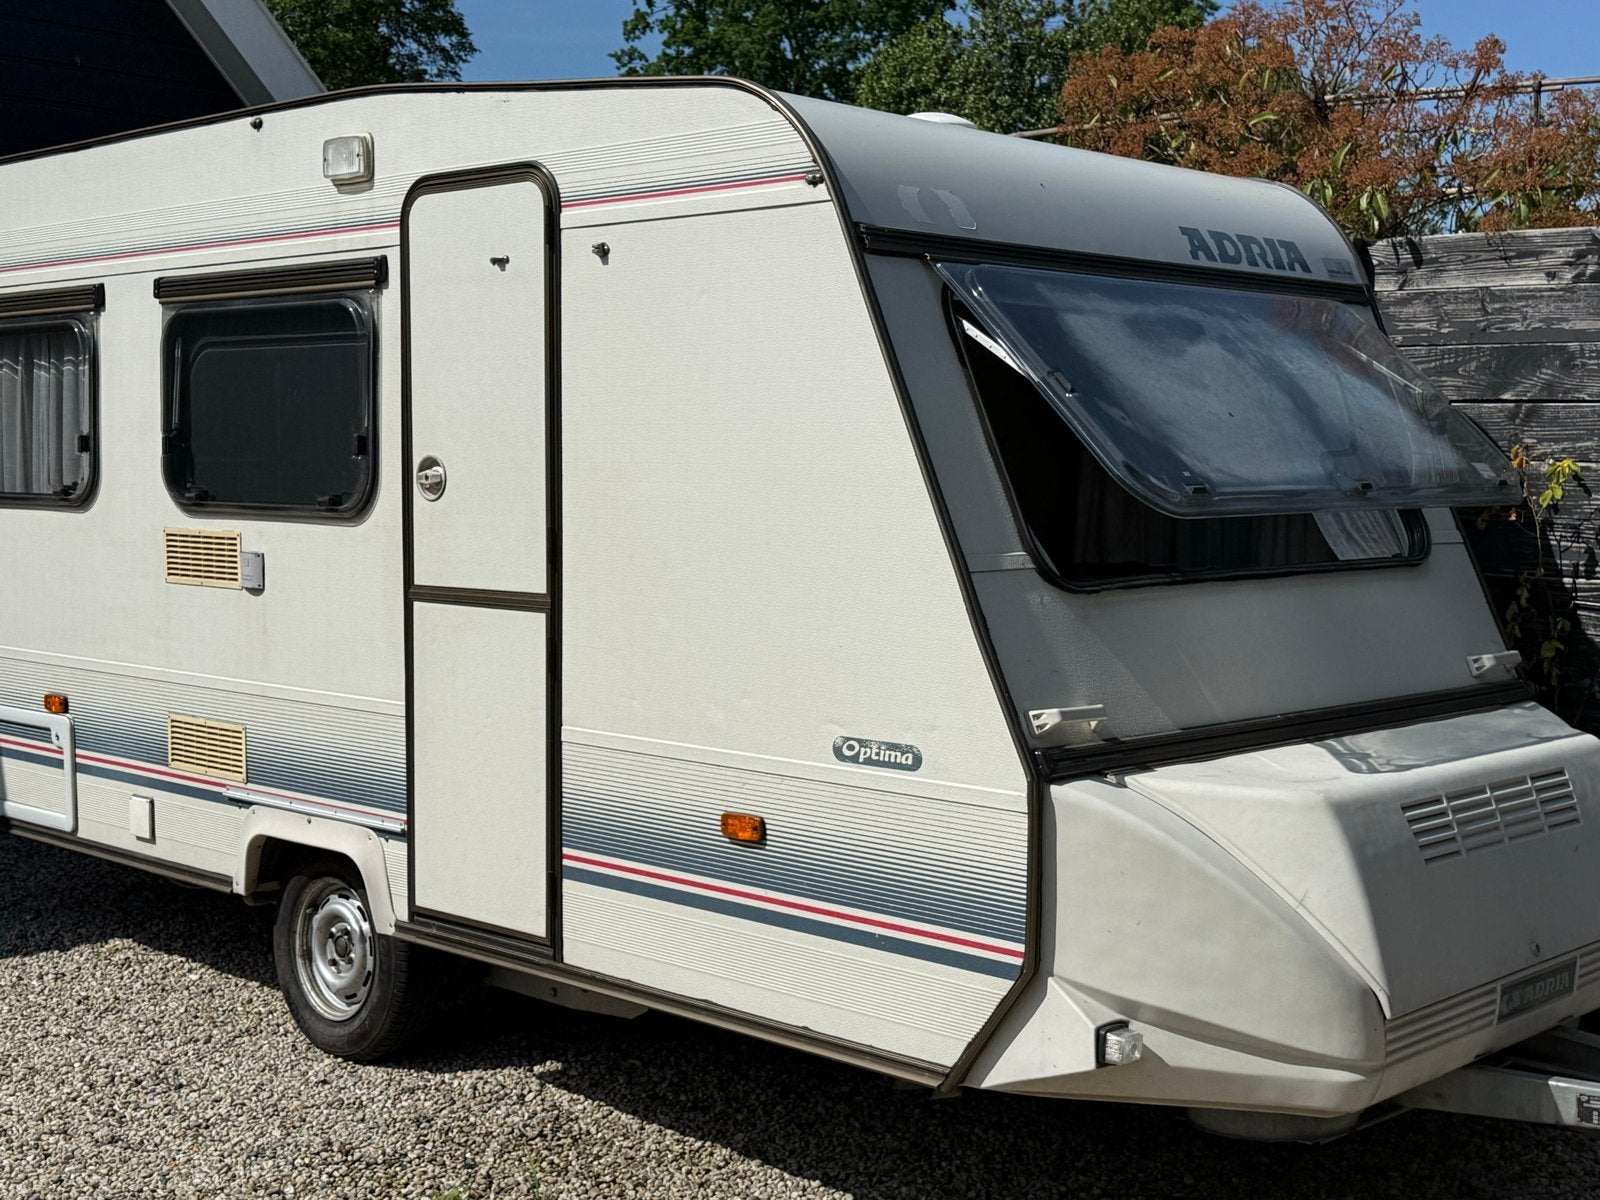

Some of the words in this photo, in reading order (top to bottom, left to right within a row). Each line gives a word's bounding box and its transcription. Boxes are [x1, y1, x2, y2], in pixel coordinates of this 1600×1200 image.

[1178, 226, 1312, 273] ADRIA
[842, 740, 913, 765] Optima
[1524, 971, 1569, 1003] ADRIA
